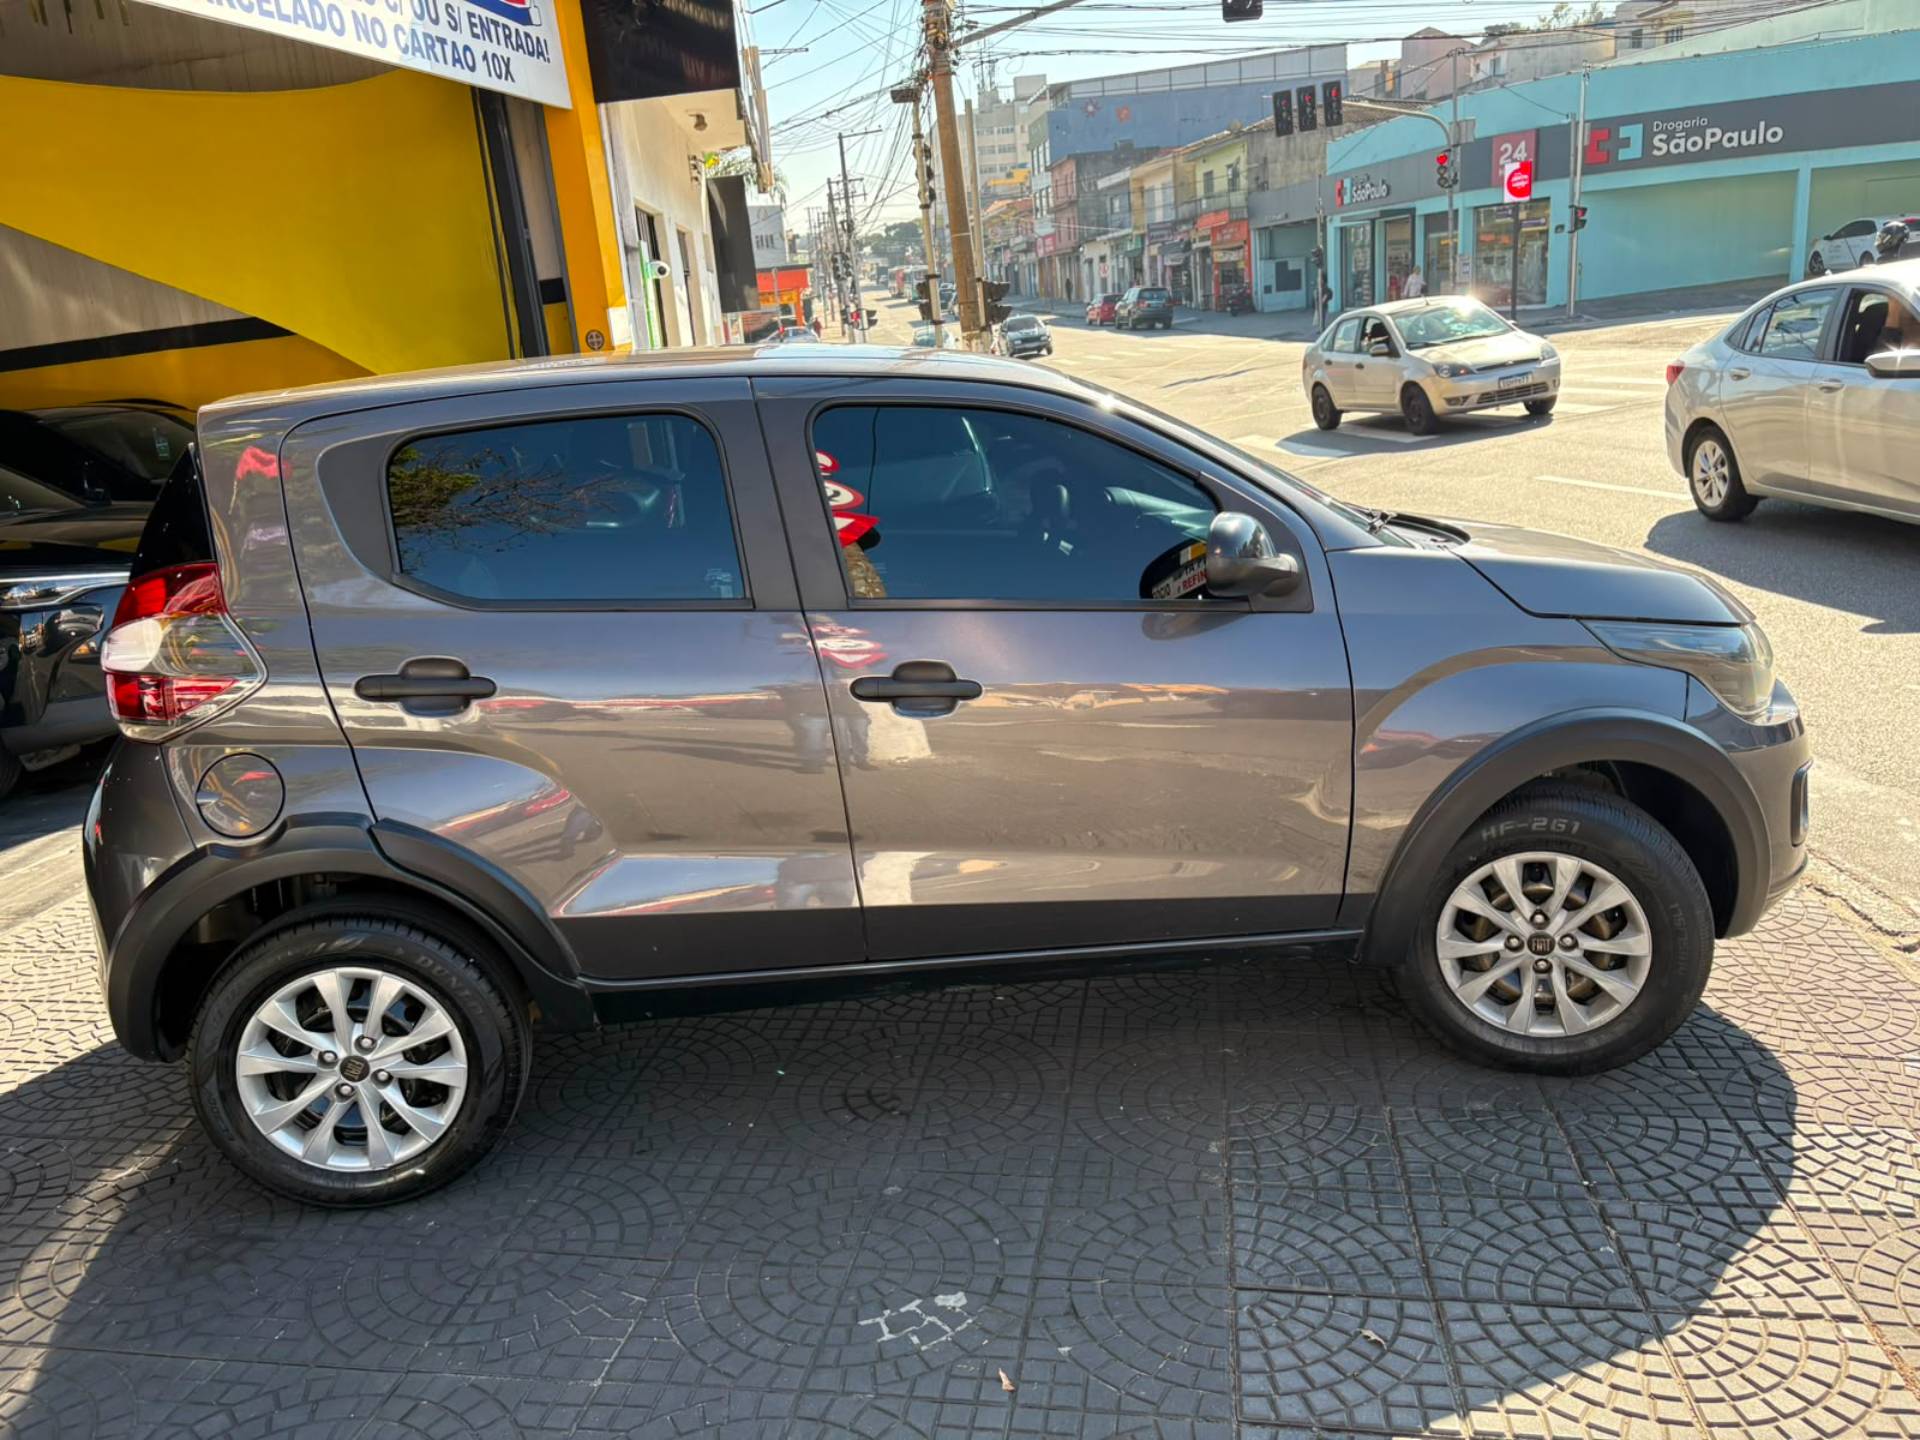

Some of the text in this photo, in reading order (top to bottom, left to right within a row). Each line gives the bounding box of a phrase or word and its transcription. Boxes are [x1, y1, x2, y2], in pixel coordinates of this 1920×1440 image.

[207, 0, 516, 84] ELADO NO CARTAO 10X
[466, 11, 551, 64] ENTRADA!
[1652, 120, 1784, 156] SãoPaulo
[1653, 116, 1709, 131] Drogaria
[1499, 140, 1527, 166] 24
